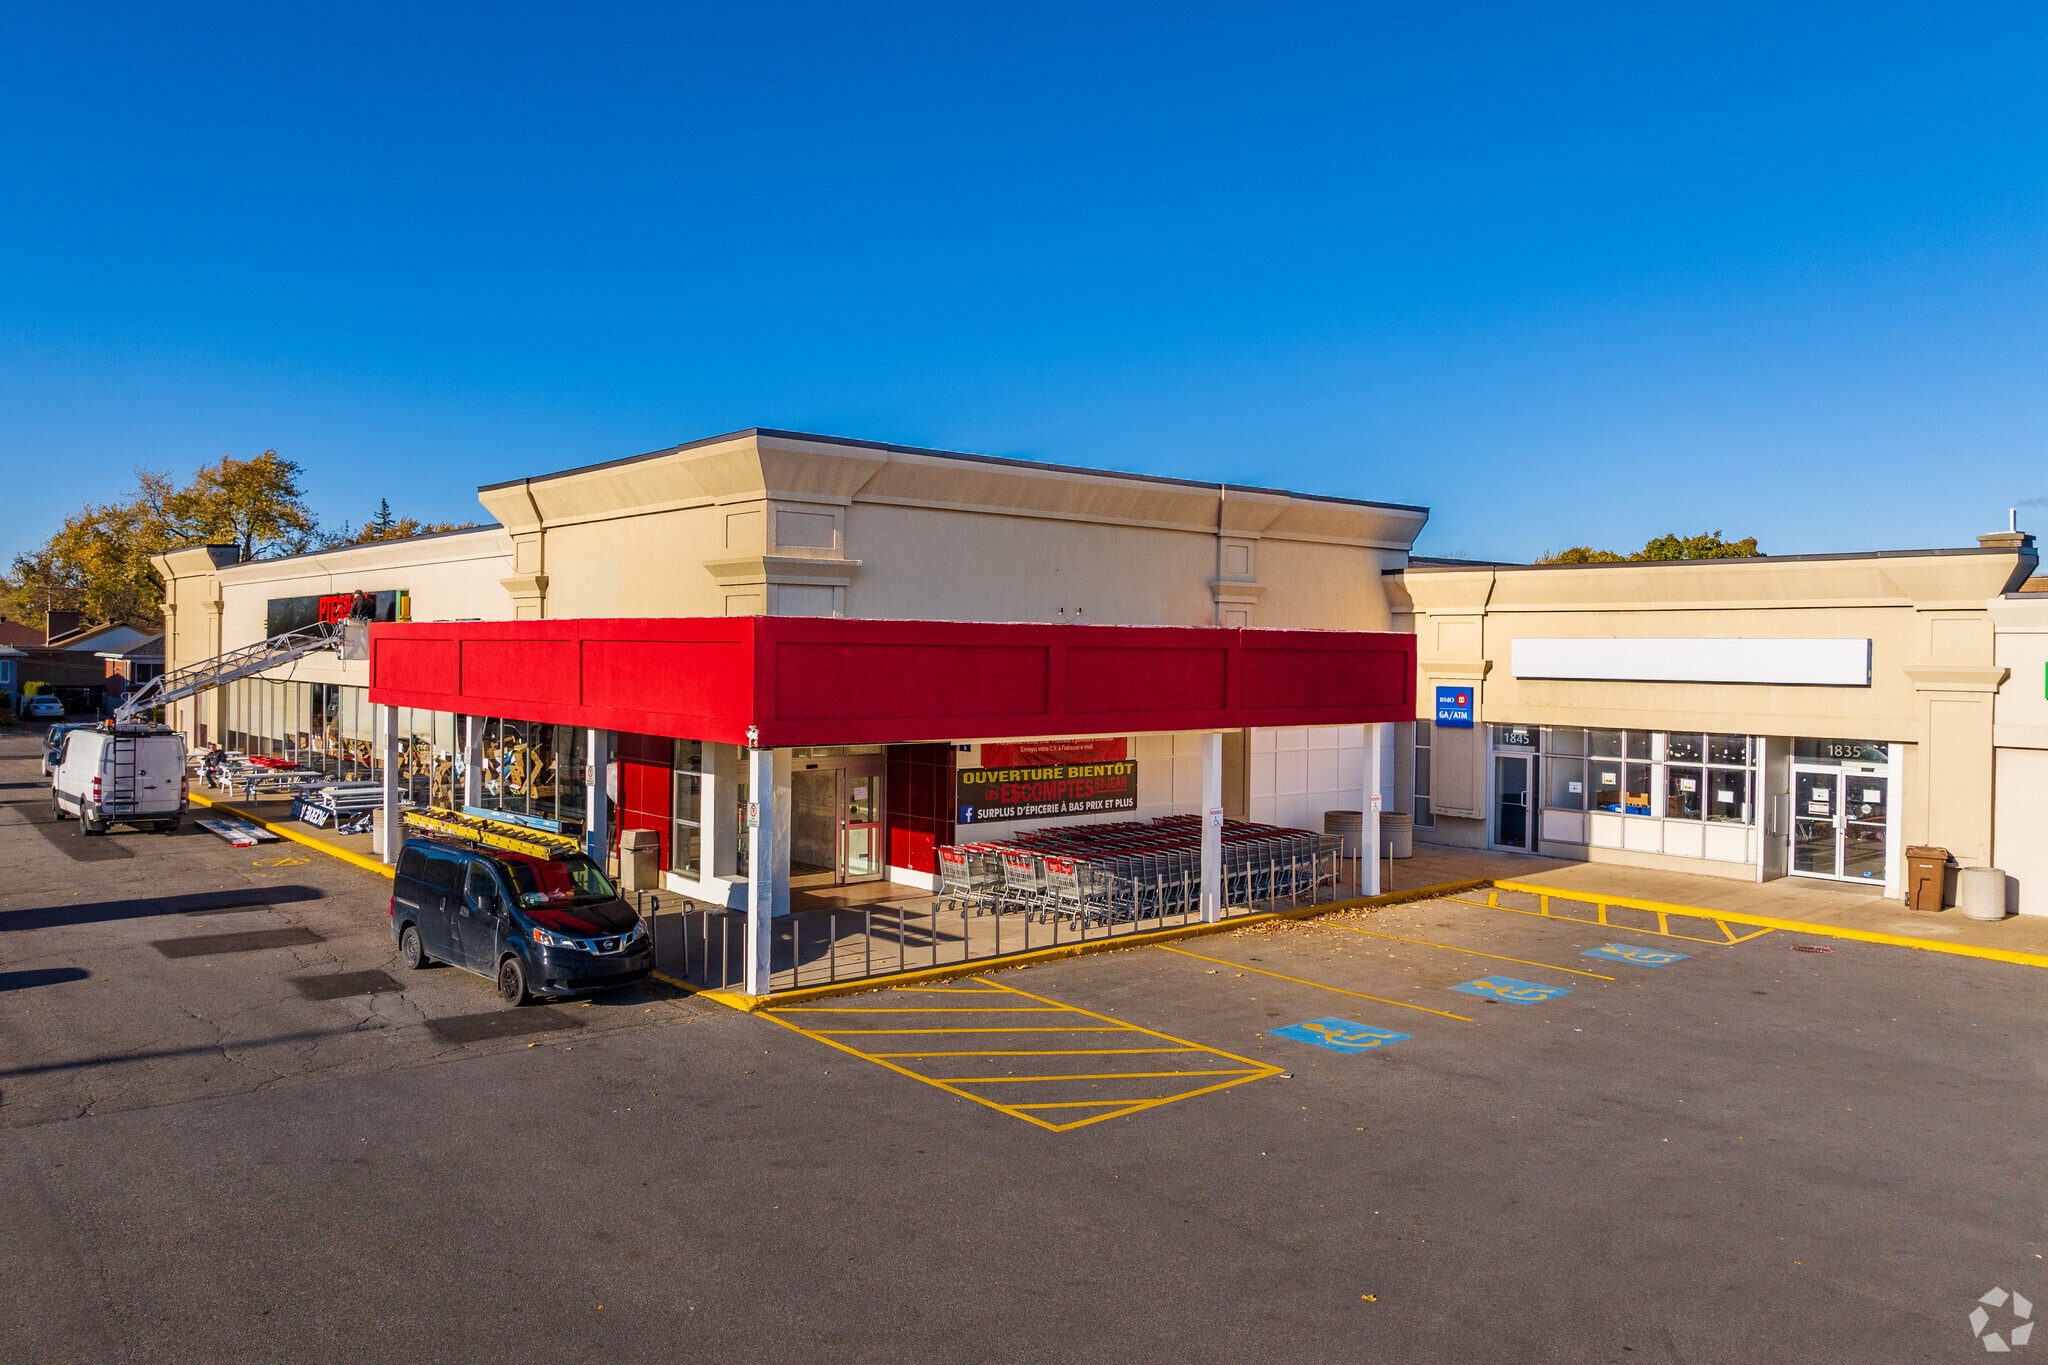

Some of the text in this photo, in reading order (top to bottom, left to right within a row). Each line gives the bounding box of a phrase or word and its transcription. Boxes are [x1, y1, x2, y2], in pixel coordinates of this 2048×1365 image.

[1438, 710, 1468, 720] GA/ATM
[1503, 732, 1530, 744] 1845
[1827, 744, 1861, 757] 1835
[963, 762, 1134, 784] OUVERTURE BIENTÔT
[985, 789, 999, 801] LES
[1094, 776, 1127, 790] ST-JEAN
[977, 798, 1134, 819] SURPLUS D'ÉPICERIE À BAS PRIX ET PLUS
